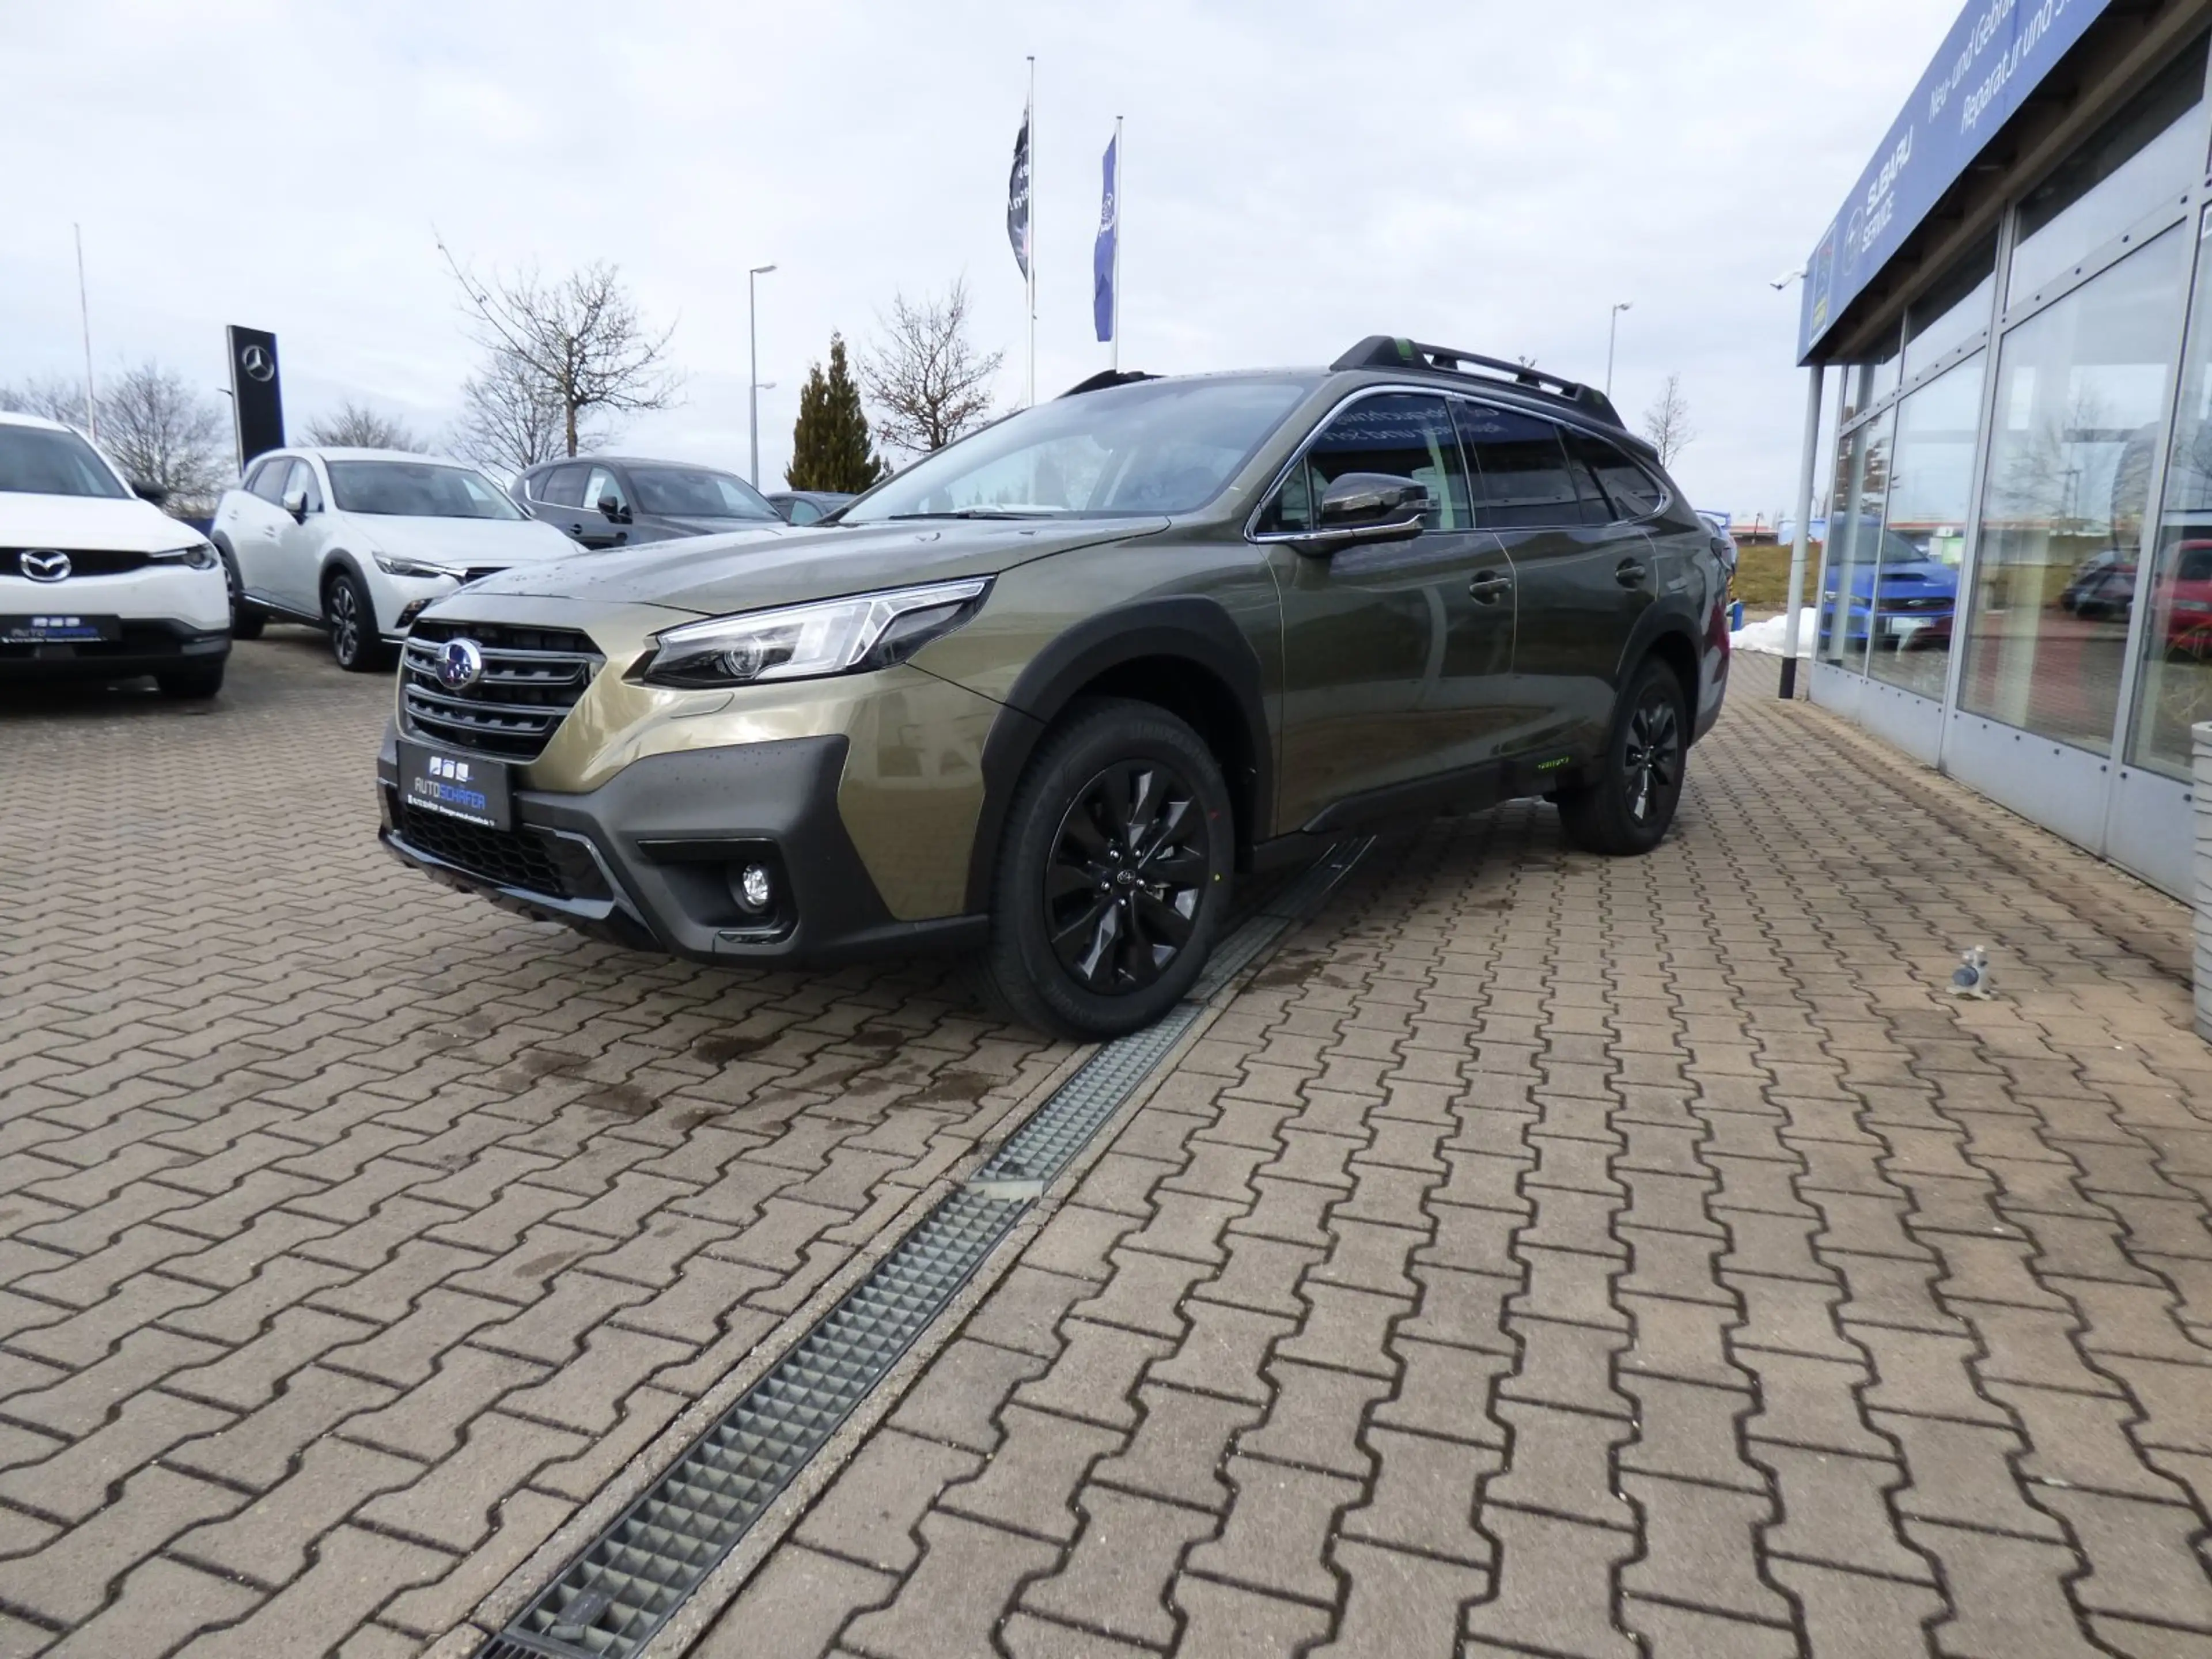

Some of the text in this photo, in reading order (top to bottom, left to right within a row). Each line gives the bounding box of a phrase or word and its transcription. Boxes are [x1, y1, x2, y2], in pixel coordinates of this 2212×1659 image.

[1974, 0, 2016, 56] Gebra
[1866, 124, 1913, 217] SUBARU
[1862, 191, 1895, 253] SERVICE
